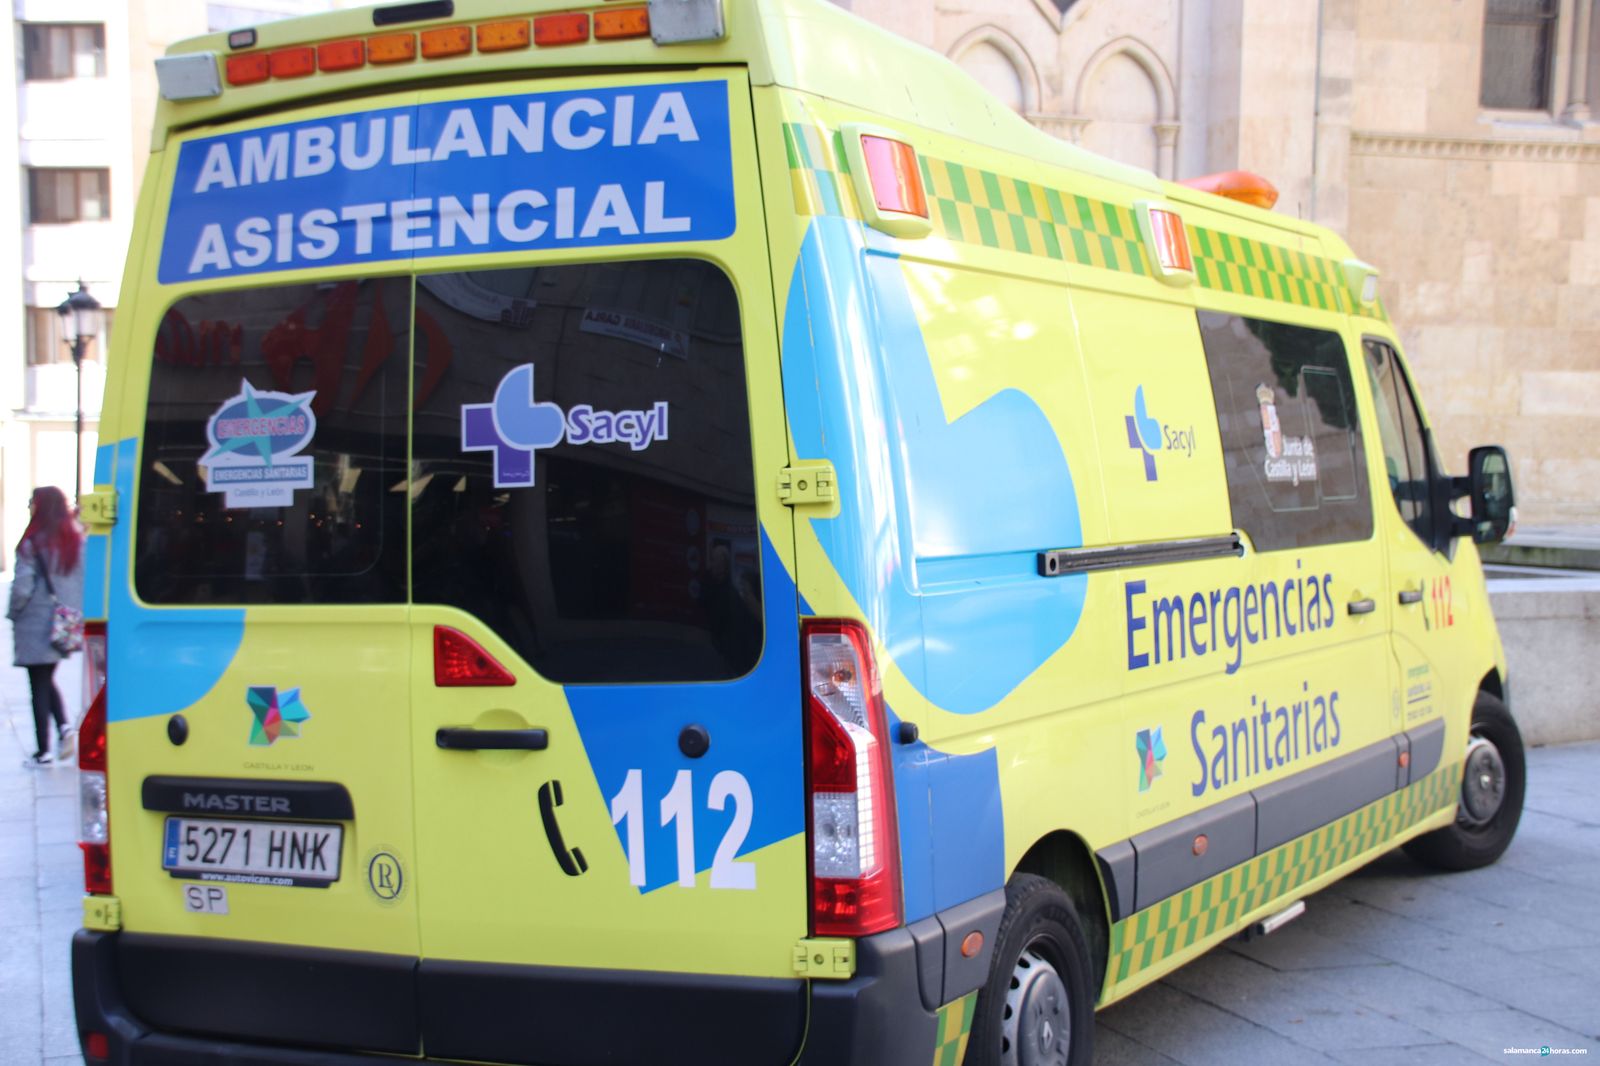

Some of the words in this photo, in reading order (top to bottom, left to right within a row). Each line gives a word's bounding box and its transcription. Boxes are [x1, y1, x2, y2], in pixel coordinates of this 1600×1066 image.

[194, 91, 700, 193] AMBULANCIA
[188, 181, 691, 274] ASISTENCIAL
[216, 415, 306, 439] EMERGENCIAS
[567, 404, 667, 449] Sacyl
[1163, 425, 1196, 458] Sacyl
[1292, 463, 1299, 487] y
[1125, 559, 1334, 675] Emergencias
[1431, 575, 1454, 630] 112
[1191, 681, 1341, 797] Sanitarias
[183, 793, 291, 812] MASTER
[185, 825, 253, 866] 5271
[267, 830, 331, 871] HNK
[611, 769, 756, 890] 112
[186, 886, 224, 911] SP
[201, 872, 294, 886] www.autovican.com
